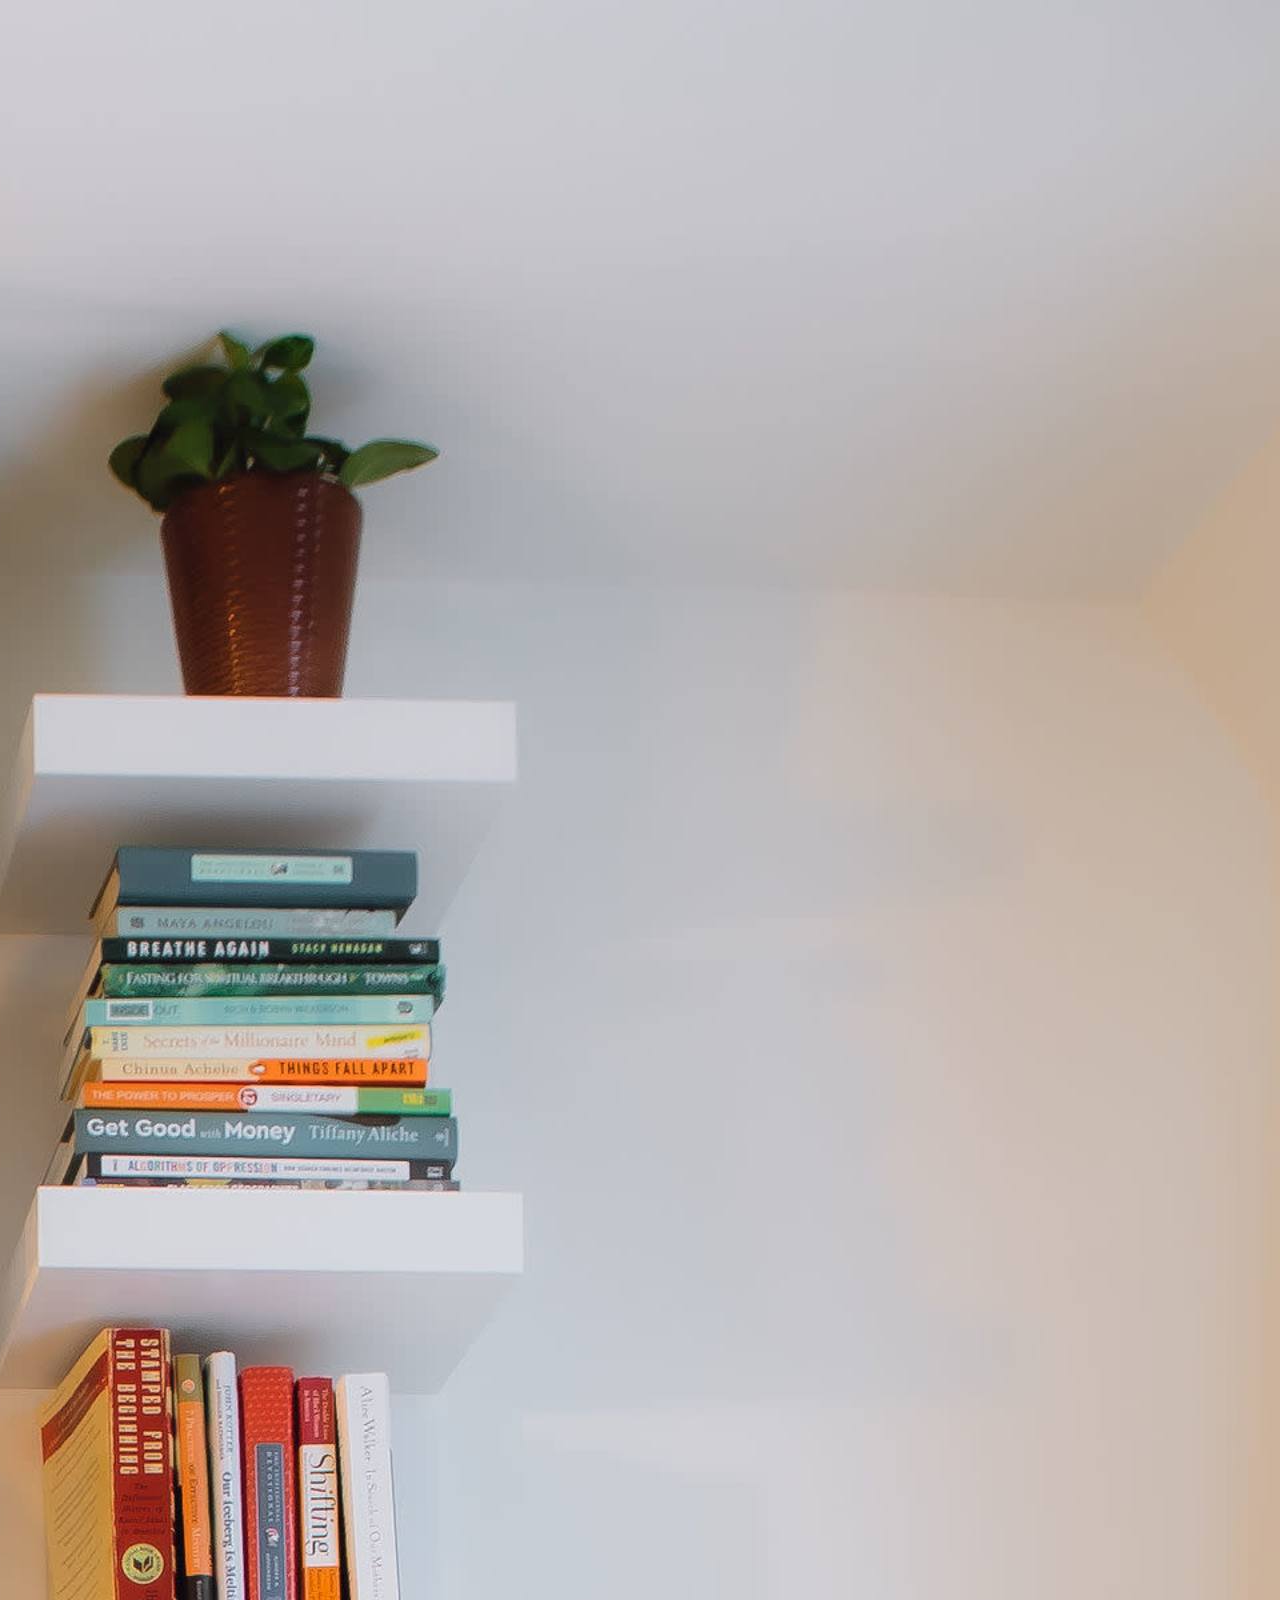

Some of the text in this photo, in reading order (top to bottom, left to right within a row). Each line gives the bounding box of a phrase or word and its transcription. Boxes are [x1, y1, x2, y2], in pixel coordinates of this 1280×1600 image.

[127, 941, 270, 956] BREATHE AGAIN
[279, 1062, 415, 1075] THINGS FALL APART
[87, 1119, 295, 1144] Get Good Money
[115, 1339, 136, 1371] THE
[139, 1339, 162, 1416] STAMPED
[306, 1454, 336, 1557] Shifting
